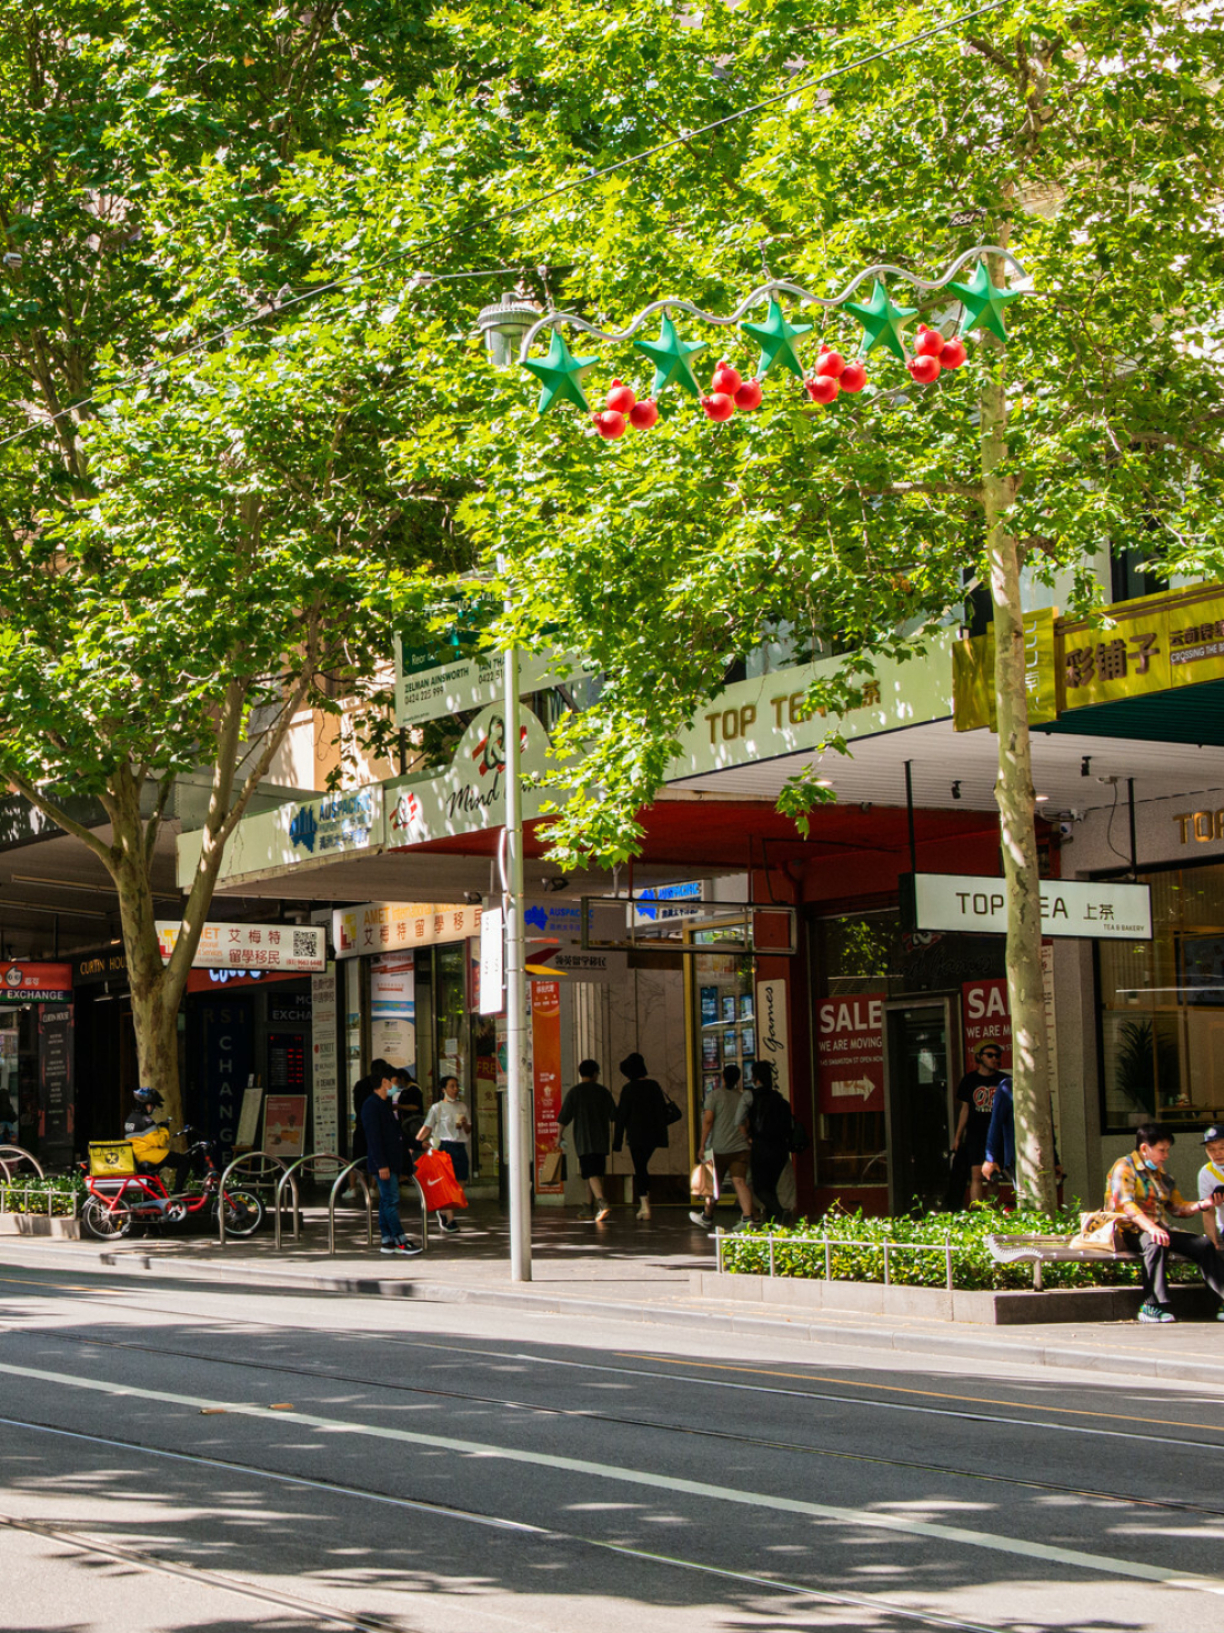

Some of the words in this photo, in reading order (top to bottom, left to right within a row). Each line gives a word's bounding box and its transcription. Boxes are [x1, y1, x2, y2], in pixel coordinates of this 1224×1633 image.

[1065, 633, 1160, 688] 彩铺子
[1171, 647, 1205, 662] CROSSING
[1205, 643, 1218, 655] THE
[404, 678, 429, 693] ZELMAN
[431, 667, 469, 685] AINSWORTH
[705, 704, 756, 744] TOP
[446, 771, 501, 818] Mind
[955, 892, 1004, 915] TOP
[1040, 896, 1069, 919] EA
[1083, 902, 1115, 921] 上茶
[364, 906, 390, 926] AMET
[228, 928, 281, 945] 艾梅特
[1103, 923, 1114, 931] TEA
[1119, 924, 1145, 932] BAKERY
[79, 958, 106, 975] CURTIN
[109, 955, 127, 970] HOU
[229, 948, 281, 966] 留學移民
[6, 989, 64, 1000] EXCHANGE
[967, 986, 1011, 1019] SA
[271, 1010, 312, 1021] EXCHA
[761, 986, 785, 1053] Games
[819, 1000, 882, 1034] SALE
[965, 1026, 981, 1038] WE
[982, 1024, 1001, 1038] ARE
[818, 1040, 831, 1052] WE
[832, 1040, 848, 1051] ARE
[850, 1036, 883, 1050] MOVING
